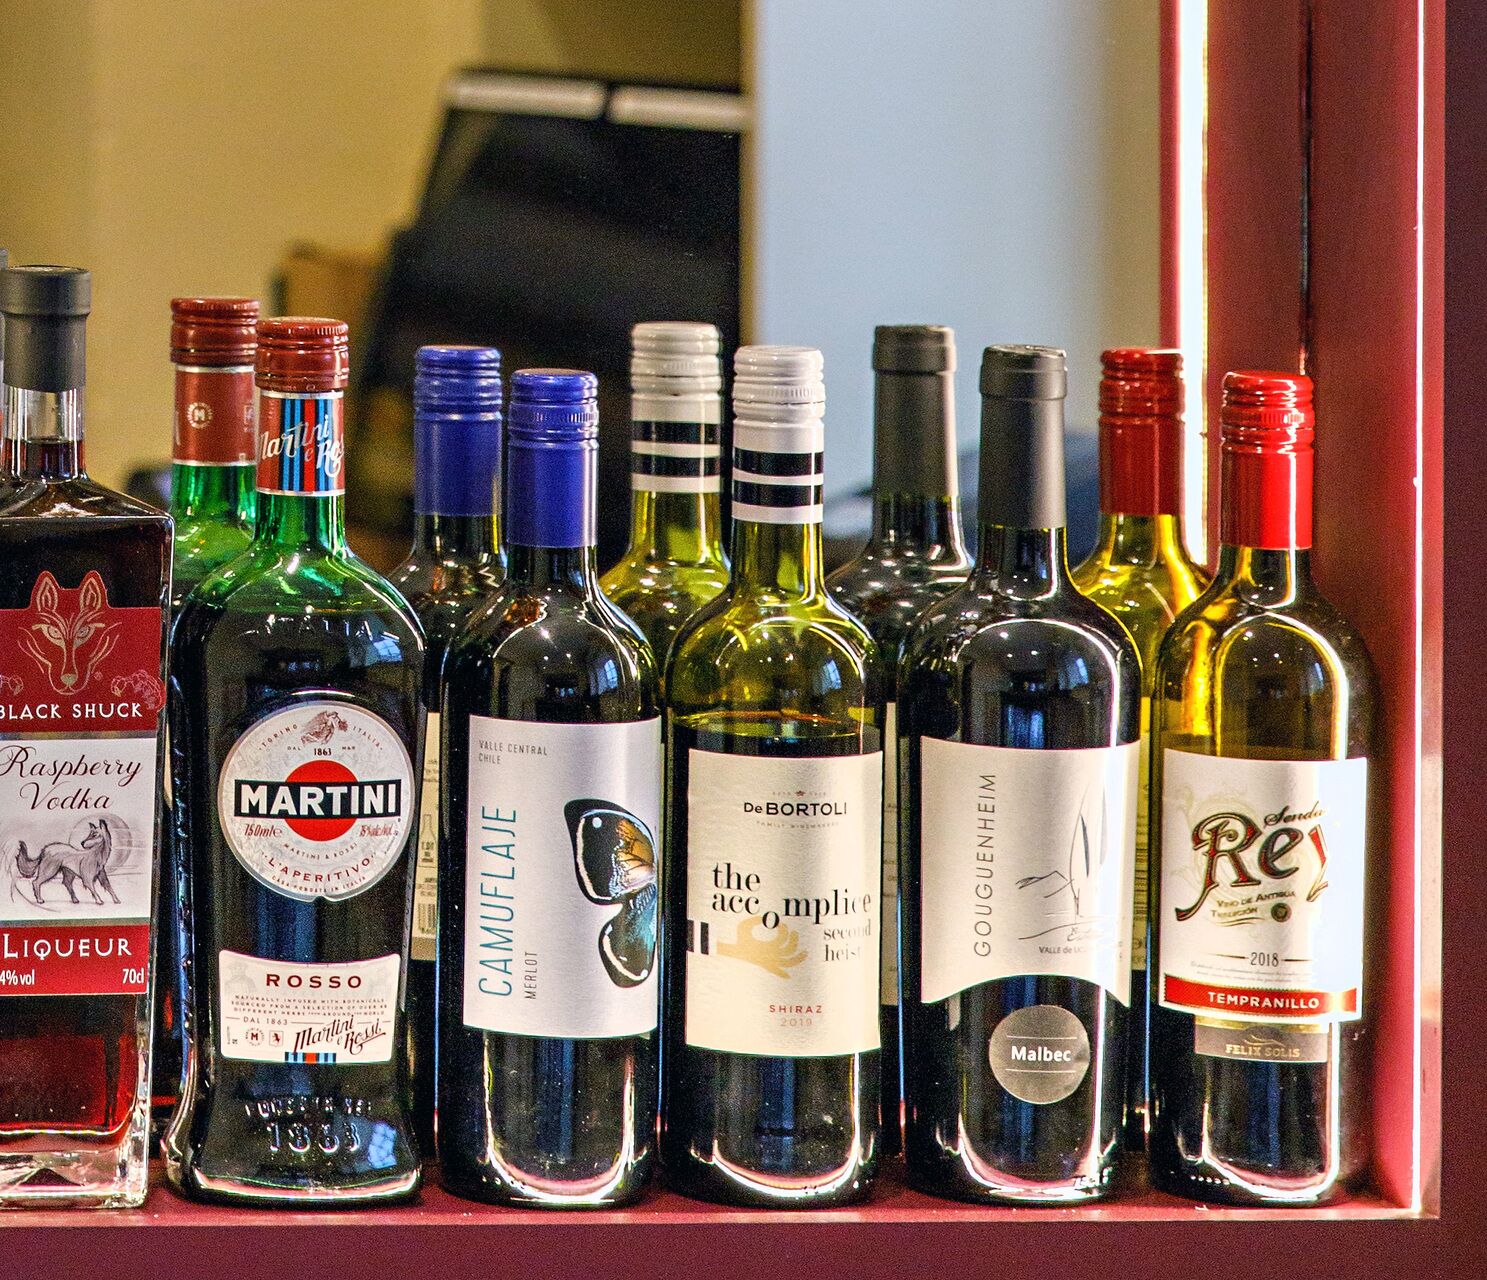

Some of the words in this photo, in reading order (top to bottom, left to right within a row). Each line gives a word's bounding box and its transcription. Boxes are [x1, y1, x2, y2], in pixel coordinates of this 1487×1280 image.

[72, 702, 144, 720] SHUCK
[478, 739, 504, 754] VALLE
[507, 742, 548, 756] CENTRAL
[478, 752, 502, 766] CHILE
[19, 782, 113, 811] Vodka
[240, 783, 396, 817] MARTINI
[268, 856, 372, 883] L'APERITIVO
[712, 862, 760, 892] the
[973, 774, 998, 958] GOUGUENHEIM
[1174, 811, 1329, 922] Rey
[478, 806, 516, 997] CAMUFLAJE
[712, 888, 872, 930] accomplice
[3, 931, 132, 960] LIQUEUR
[1250, 952, 1280, 968] 2018
[122, 966, 146, 985] 70cl
[266, 974, 362, 988] ROSSO
[524, 950, 538, 1000] MERLOT
[768, 1004, 824, 1015] SHIRAZ
[1208, 990, 1320, 1010] TEMPRANILLO
[242, 1016, 260, 1024] DAL
[266, 1016, 288, 1026] 1863
[1010, 1044, 1072, 1063] Malbec
